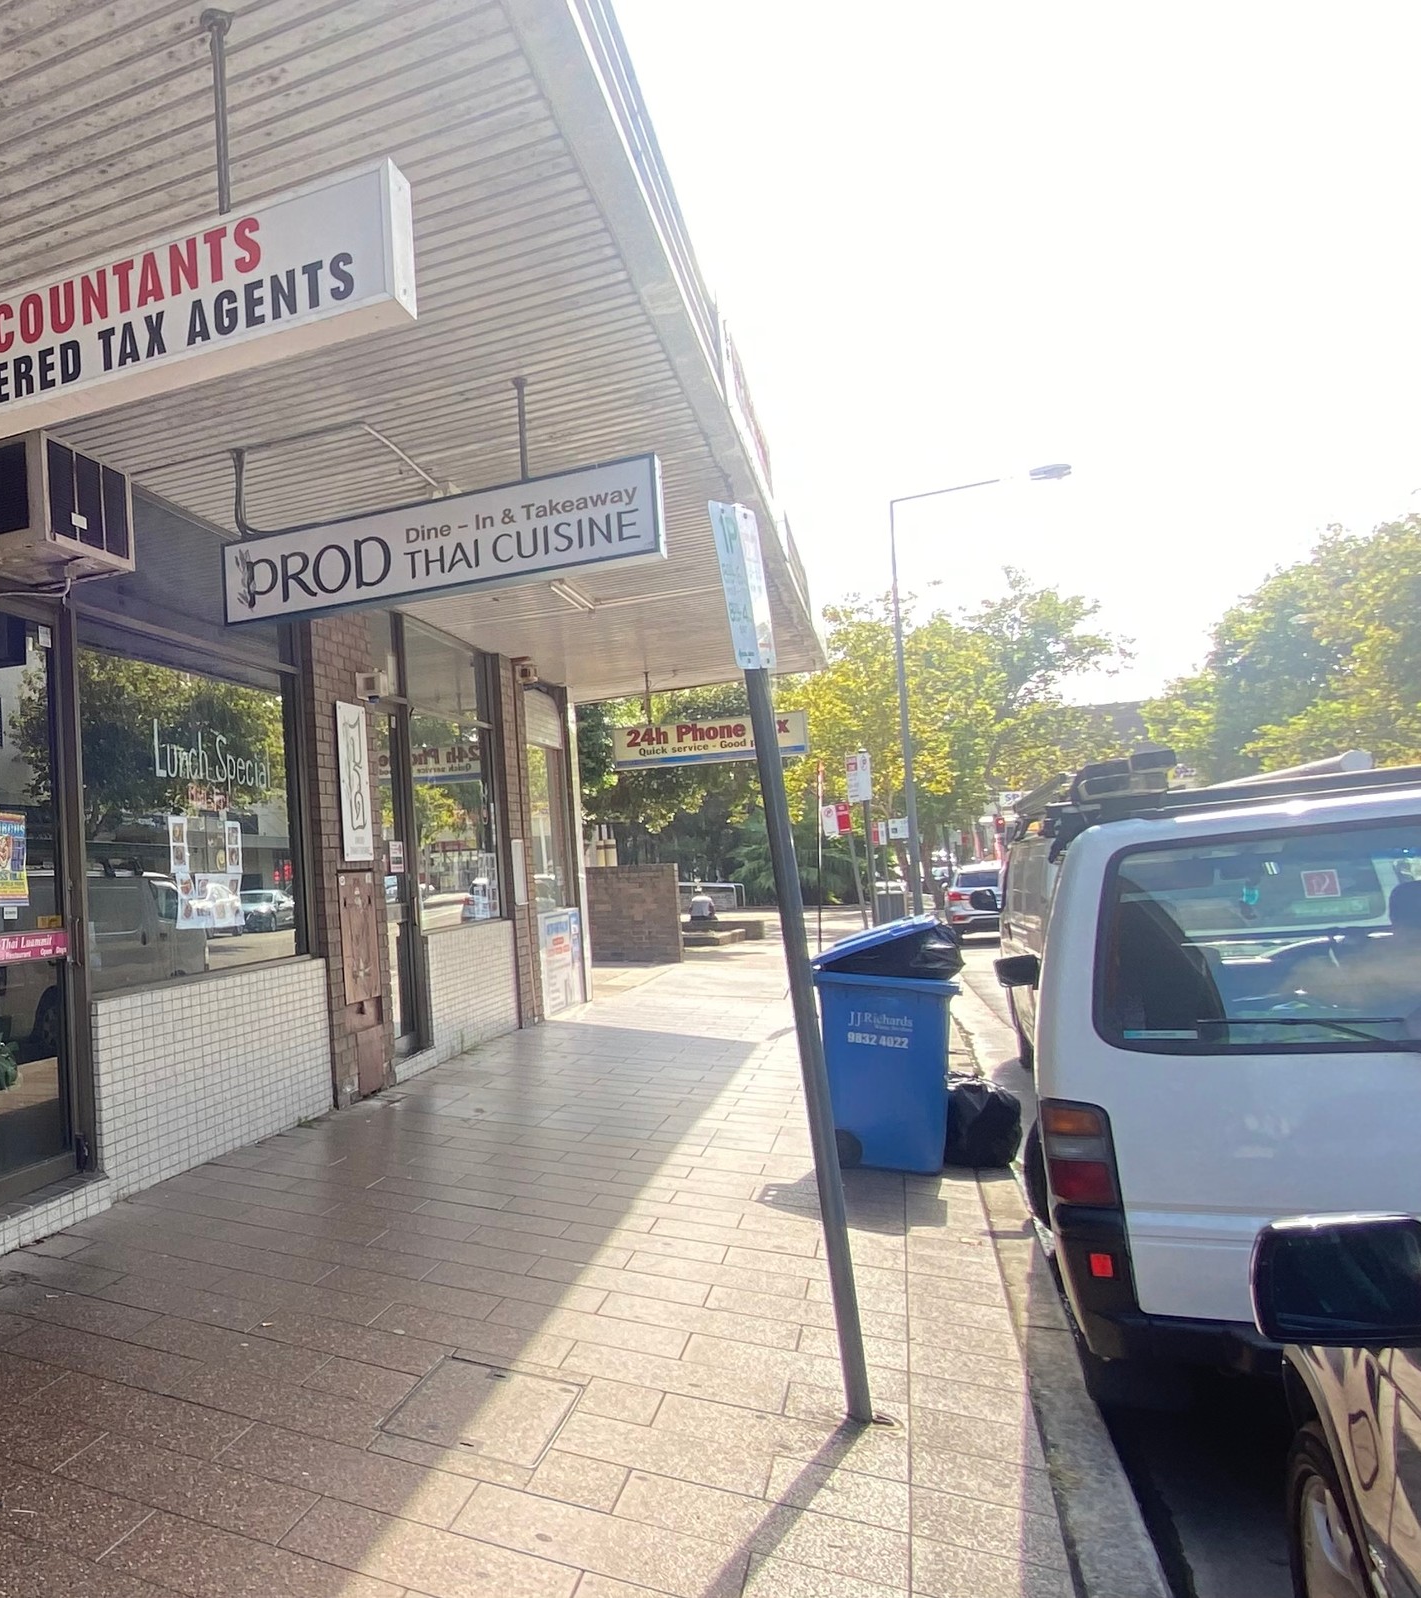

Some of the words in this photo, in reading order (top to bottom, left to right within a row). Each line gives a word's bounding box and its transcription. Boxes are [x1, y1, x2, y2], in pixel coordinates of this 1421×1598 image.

[98, 312, 167, 372] TAX
[187, 253, 354, 347] AGENTS
[404, 539, 480, 580] THAI
[492, 508, 640, 563] CUISINE
[405, 524, 452, 544] Dine
[475, 513, 495, 530] In
[501, 511, 516, 524] &
[522, 486, 637, 520] Takeaway
[238, 536, 391, 611] PROD
[153, 719, 211, 780] Lunch
[215, 734, 271, 791] Special
[626, 728, 668, 748] 24h
[676, 722, 746, 744] Phone
[638, 746, 667, 756] Quick
[671, 742, 709, 754] service
[720, 739, 747, 748] Good
[848, 1032, 877, 1045] 9832
[879, 1035, 908, 1049] 4022
[864, 1012, 913, 1027] Richards
